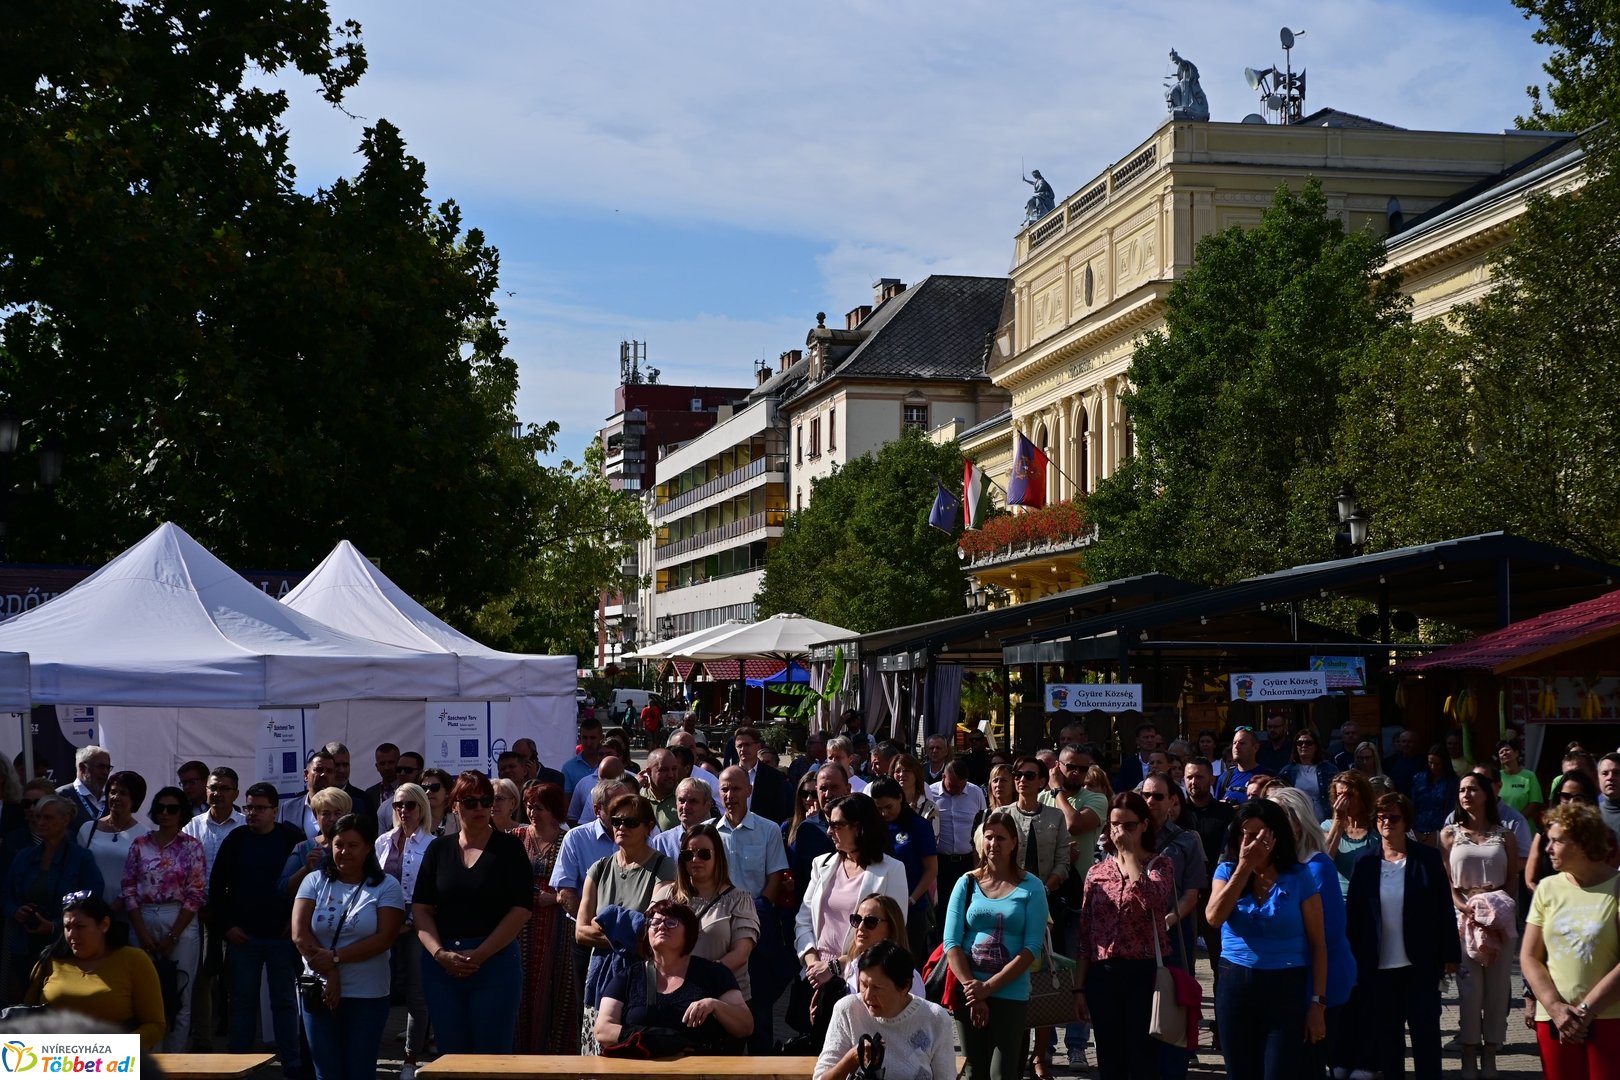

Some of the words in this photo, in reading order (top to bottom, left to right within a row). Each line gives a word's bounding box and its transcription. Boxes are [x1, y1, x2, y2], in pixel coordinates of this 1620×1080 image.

[1263, 679, 1287, 687] Gyüre
[1290, 678, 1318, 686] Község
[1078, 690, 1102, 699] Gyüre
[1105, 690, 1133, 699] Község
[1260, 687, 1322, 697] Önkormányzata
[1074, 699, 1137, 709] Önkormányzata
